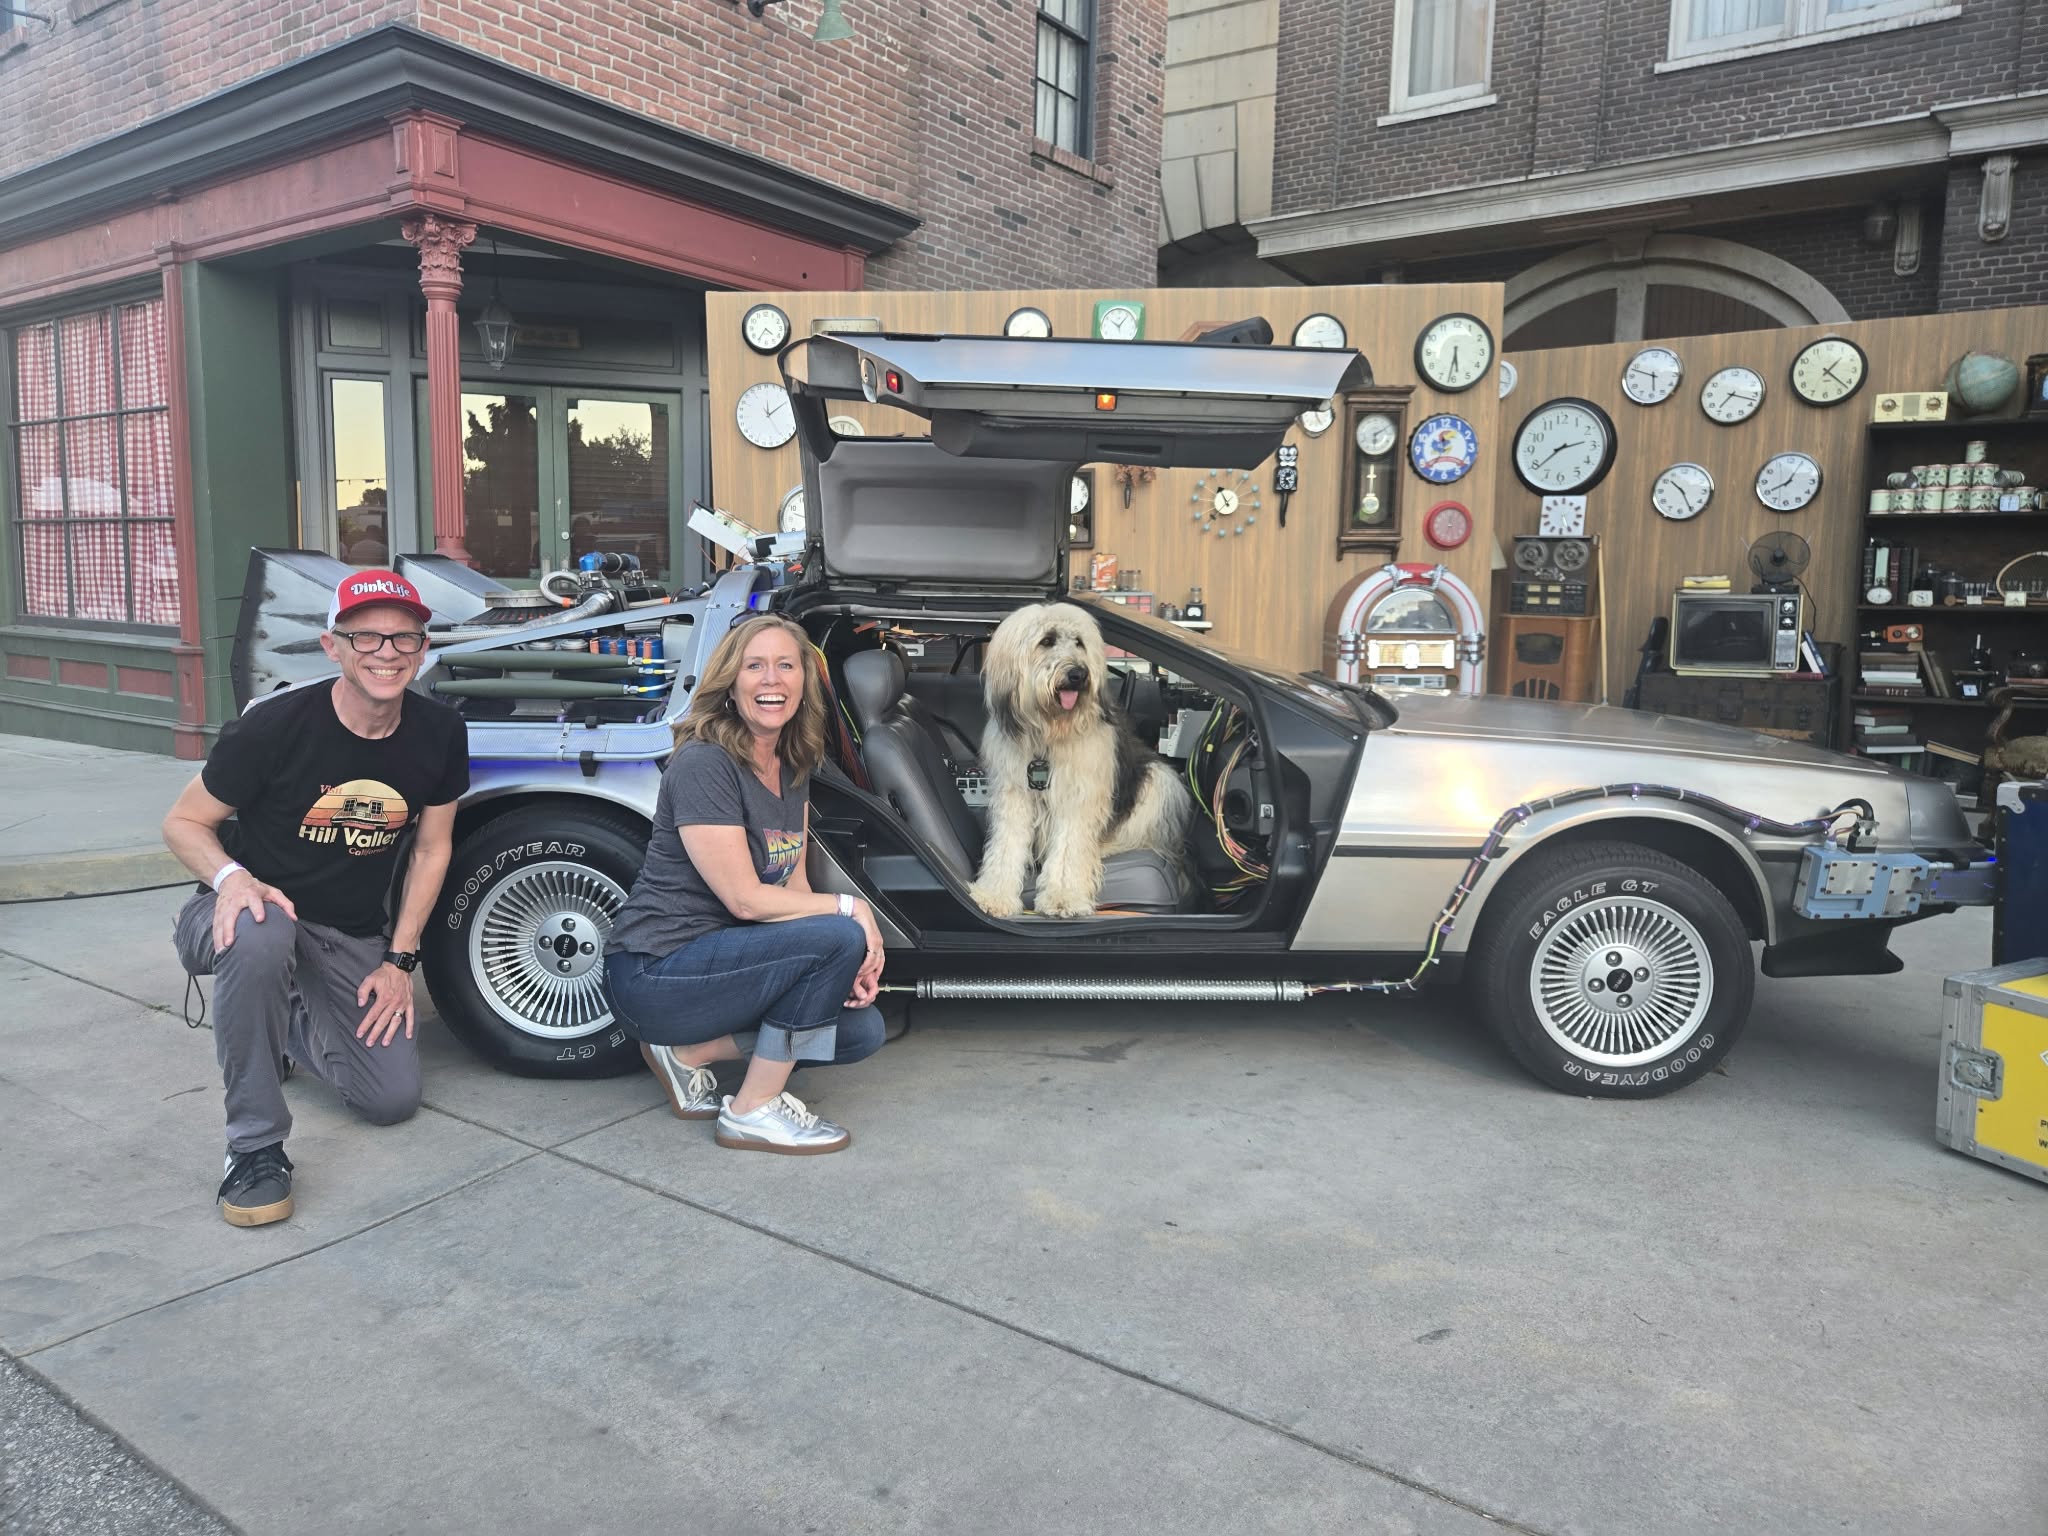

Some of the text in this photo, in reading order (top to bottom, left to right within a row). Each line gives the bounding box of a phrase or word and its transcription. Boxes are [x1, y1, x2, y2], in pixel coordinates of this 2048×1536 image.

[1440, 418, 1451, 428] 12
[1557, 414, 1568, 424] 12
[1575, 417, 1579, 427] 1
[1429, 422, 1436, 432] 11
[1456, 421, 1461, 430] 1
[1544, 420, 1552, 431] 11
[1584, 426, 1591, 435] 2
[1418, 433, 1428, 442] 10
[1465, 431, 1472, 440] 2
[1533, 432, 1544, 442] 10
[1468, 443, 1475, 452] 3
[1527, 445, 1535, 455] 9
[1589, 440, 1597, 450] 3
[1415, 446, 1421, 455] 9
[1420, 459, 1425, 468] 8
[1464, 456, 1470, 465] 4
[1531, 459, 1539, 470] 8
[1584, 456, 1590, 464] 4
[1430, 467, 1435, 476] 7
[1441, 471, 1448, 479] 6
[1544, 469, 1551, 479] 7
[1574, 467, 1581, 479] 5
[1556, 472, 1564, 482] 6
[299, 826, 400, 848] Hill Valley
[448, 842, 585, 929] GOODYEAR
[1529, 880, 1659, 940] EAGLE GT
[557, 1044, 596, 1060] GT
[1563, 1034, 1714, 1085] GOODYEAR
